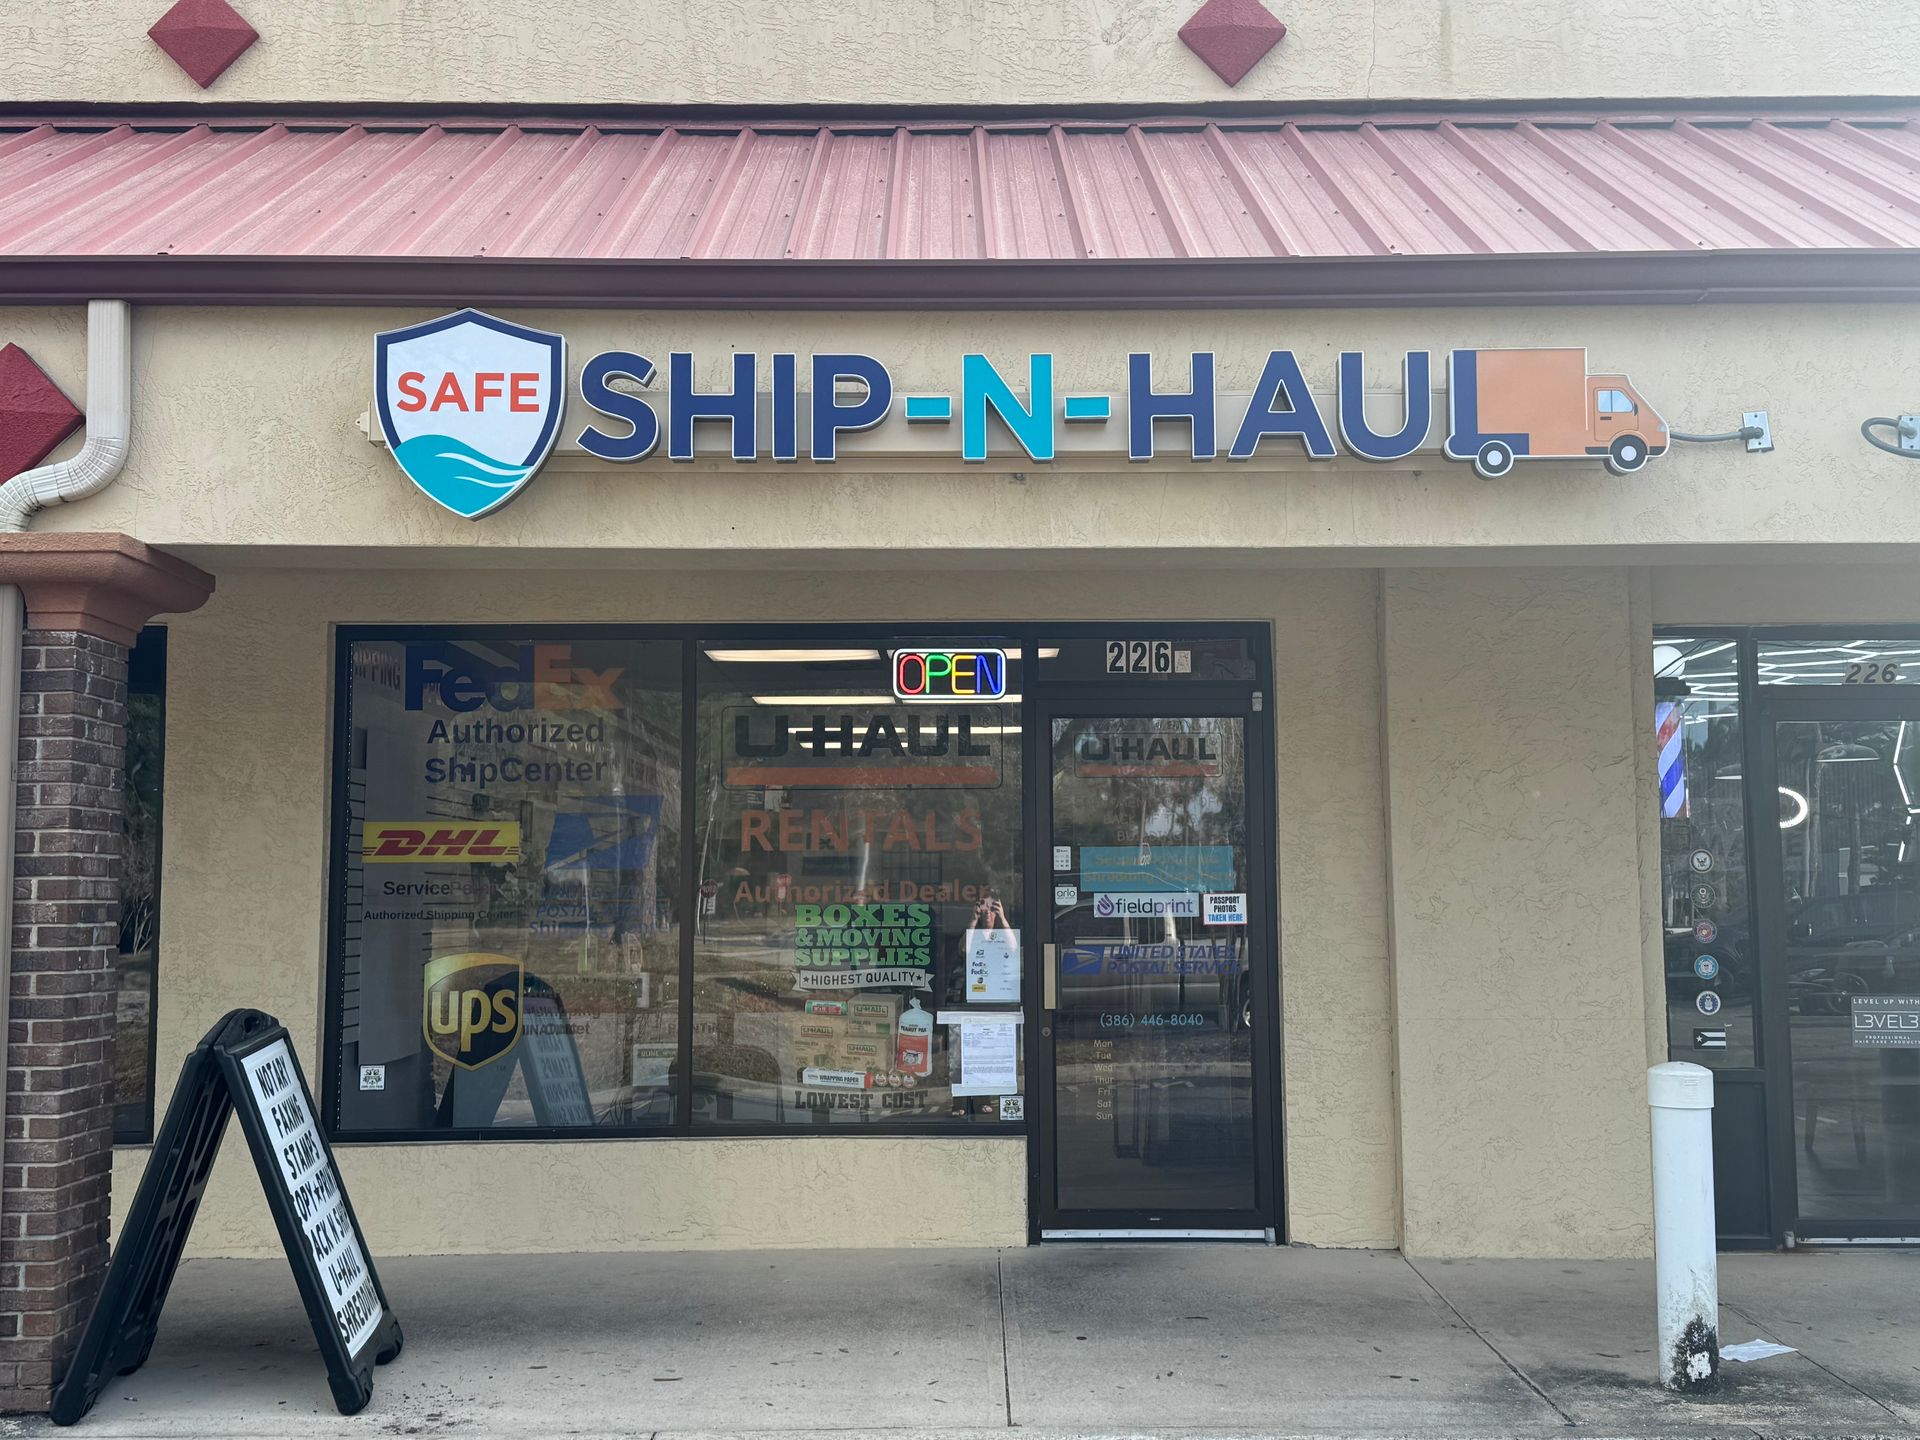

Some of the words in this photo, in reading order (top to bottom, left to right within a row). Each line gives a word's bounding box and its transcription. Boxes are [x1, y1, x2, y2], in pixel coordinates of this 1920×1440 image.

[396, 370, 541, 414] SAFE
[1108, 642, 1170, 673] 226
[404, 645, 626, 712] FedEx
[899, 654, 1002, 694] OPEN
[1845, 662, 1898, 684] 226
[427, 717, 605, 745] Authorized
[735, 714, 991, 757] U-HAUL
[1081, 737, 1217, 761] U-HAUL
[424, 756, 608, 789] ShipCenter
[740, 809, 983, 851] RENTALS
[373, 829, 508, 857] DHL
[908, 880, 989, 902] Dealer
[1057, 888, 1076, 897] arlo
[1209, 896, 1240, 905] PASSPORT
[364, 910, 424, 920] Authorized
[424, 910, 475, 921] Shipping
[795, 903, 931, 928] BOXES
[1115, 896, 1194, 916] fieldprint
[1213, 904, 1237, 913] PHOTOS
[1208, 913, 1228, 922] TAKEN
[1228, 913, 1244, 922] HERE
[816, 928, 931, 947] MOVING
[794, 948, 931, 967] SUPPLIES
[1109, 944, 1176, 959] UNITED
[1178, 944, 1236, 959] STATES
[811, 973, 863, 986] HIGHEST
[866, 971, 916, 984] QUALITY
[1106, 960, 1171, 976] POSTAL
[430, 989, 516, 1052] ups
[1099, 1013, 1135, 1028] (386)
[1140, 1013, 1204, 1026] 446-8040
[1093, 1039, 1113, 1048] Mon
[1095, 1051, 1112, 1060] Tue
[255, 1055, 292, 1101] NOTARY
[820, 1074, 843, 1082] WRAPPING
[1094, 1063, 1113, 1072] Wed
[794, 1090, 874, 1109] LOWEST
[881, 1089, 928, 1109] COST
[1098, 1088, 1112, 1096] Fri
[1096, 1100, 1112, 1108] Sat
[271, 1093, 305, 1139] FAXING
[1096, 1112, 1113, 1120] Sun
[283, 1129, 320, 1180] STAMPS
[294, 1181, 318, 1222] OPY
[310, 1219, 335, 1263] ACK
[328, 1244, 361, 1297] U-HAUL
[336, 1274, 379, 1344] SHREDDING
